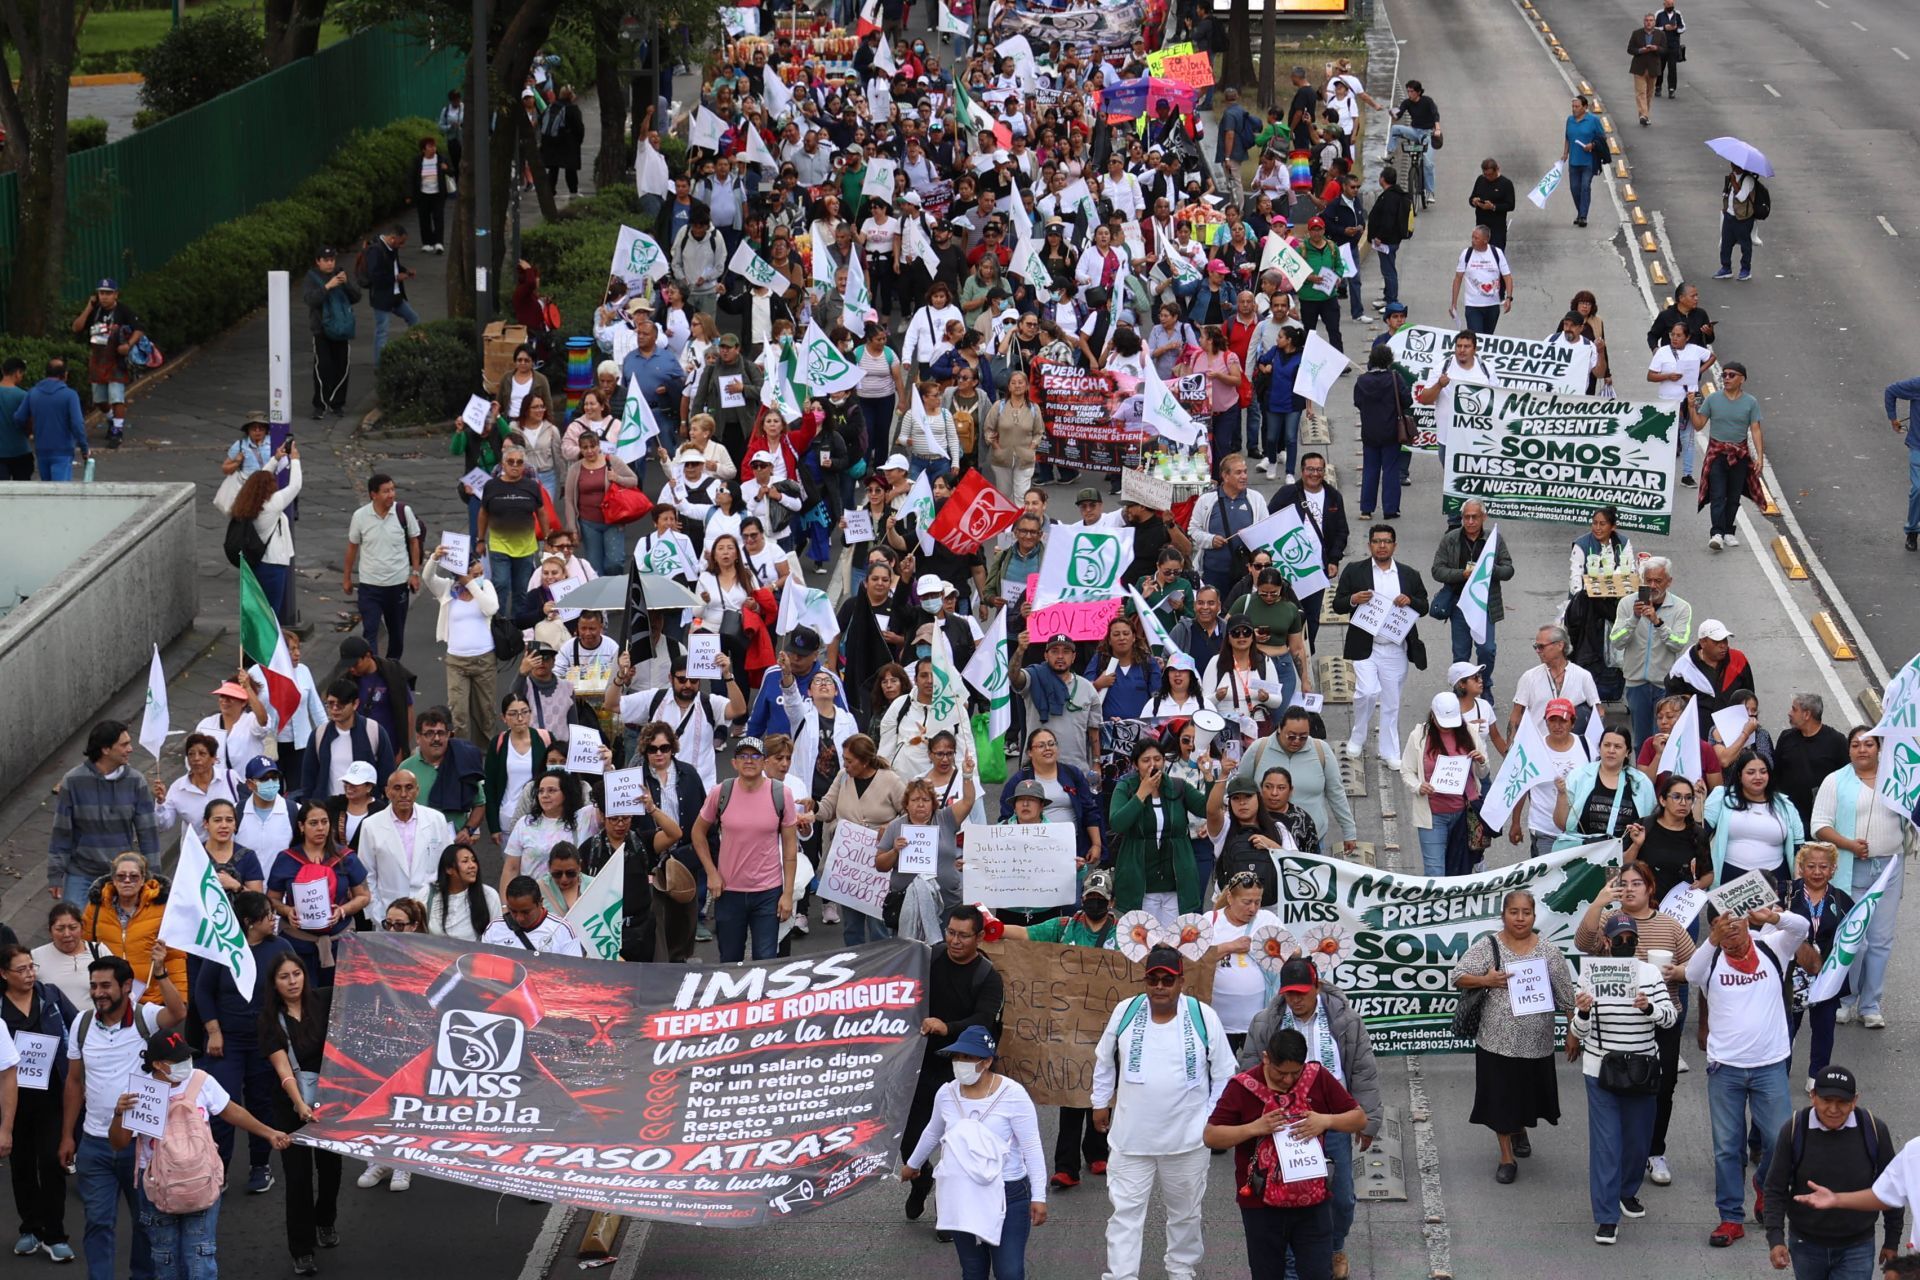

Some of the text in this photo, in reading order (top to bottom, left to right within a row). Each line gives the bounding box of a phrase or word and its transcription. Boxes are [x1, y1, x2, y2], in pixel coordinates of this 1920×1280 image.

[1441, 334, 1574, 363] MCHOACÁN
[1402, 351, 1433, 364] IMSS
[1041, 364, 1085, 378] PUEBLO
[1044, 375, 1108, 391] ESCUCHA
[1180, 392, 1206, 401] IMSS
[1499, 393, 1633, 420] Michoacán
[1453, 414, 1493, 430] IMSS
[1520, 418, 1609, 435] PRESENTE
[1500, 436, 1621, 466] SOMOS
[1458, 455, 1661, 490] IMSS-COPLAMAR
[1461, 478, 1662, 509] ¿Y NUESTRA HOMOLOGACIÓN?
[1491, 502, 1518, 511] Decreto
[1520, 504, 1562, 514] Presidencial
[1563, 507, 1575, 515] del
[1581, 508, 1589, 516] de
[1359, 613, 1379, 628] IMSS
[1383, 622, 1402, 637] IMSS
[574, 755, 599, 764] IMSS
[613, 783, 637, 792] APOYO
[1436, 778, 1460, 787] IMSS
[613, 800, 639, 809] IMSS
[906, 856, 931, 865] IMSS
[306, 888, 317, 896] YO
[1348, 862, 1550, 909] Michoacán
[302, 895, 324, 904] APOYO
[1673, 894, 1695, 908] APOYO
[1684, 889, 1694, 899] YO
[1283, 903, 1340, 924] IMSS
[1733, 894, 1765, 918] IMSS
[303, 911, 327, 920] IMSS
[1664, 907, 1688, 923] IMSS
[1522, 967, 1533, 975] YO
[1590, 963, 1599, 973] Yo
[1600, 964, 1618, 974] apoyo
[1622, 964, 1630, 972] los
[674, 952, 860, 1010] IMSS
[1516, 975, 1541, 985] APOYO
[1719, 970, 1767, 986] Wilson
[1595, 983, 1626, 998] IMSS
[1518, 993, 1546, 1005] IMSS
[654, 981, 916, 1036] TEPEXI DE RODRIGUEZ
[653, 1011, 910, 1066] Unido en la lucha
[1017, 1018, 1064, 1043] QUE
[21, 1050, 47, 1058] APOYO
[1128, 1029, 1144, 1073] EXTRAORDINARIO
[16, 1066, 43, 1077] IMSS
[691, 1052, 883, 1079] Por un salario digno
[428, 1069, 522, 1098] IMSS
[688, 1067, 874, 1094] Por un retiro digno
[144, 1085, 155, 1093] YO
[687, 1080, 875, 1108] No mas violaciones
[136, 1092, 161, 1104] APOYO
[142, 1103, 153, 1111] AL
[389, 1096, 540, 1125] Puebla
[685, 1098, 829, 1120] a los estatutos
[131, 1110, 160, 1126] IMSS
[684, 1102, 873, 1133] Respeto a nuestros
[475, 1125, 534, 1134] Rodriguez
[682, 1127, 774, 1144] derechos
[350, 1126, 856, 1172] NI UN PASO ATRAS
[1289, 1156, 1318, 1168] IMSS
[563, 1169, 660, 1189] también
[665, 1180, 688, 1190] es
[694, 1177, 720, 1190] tu
[726, 1174, 792, 1191] lucha
[823, 1177, 851, 1197] PARA
[828, 1172, 851, 1188] MAS
[447, 1168, 479, 1180] salud
[675, 1201, 733, 1210] invitamos
